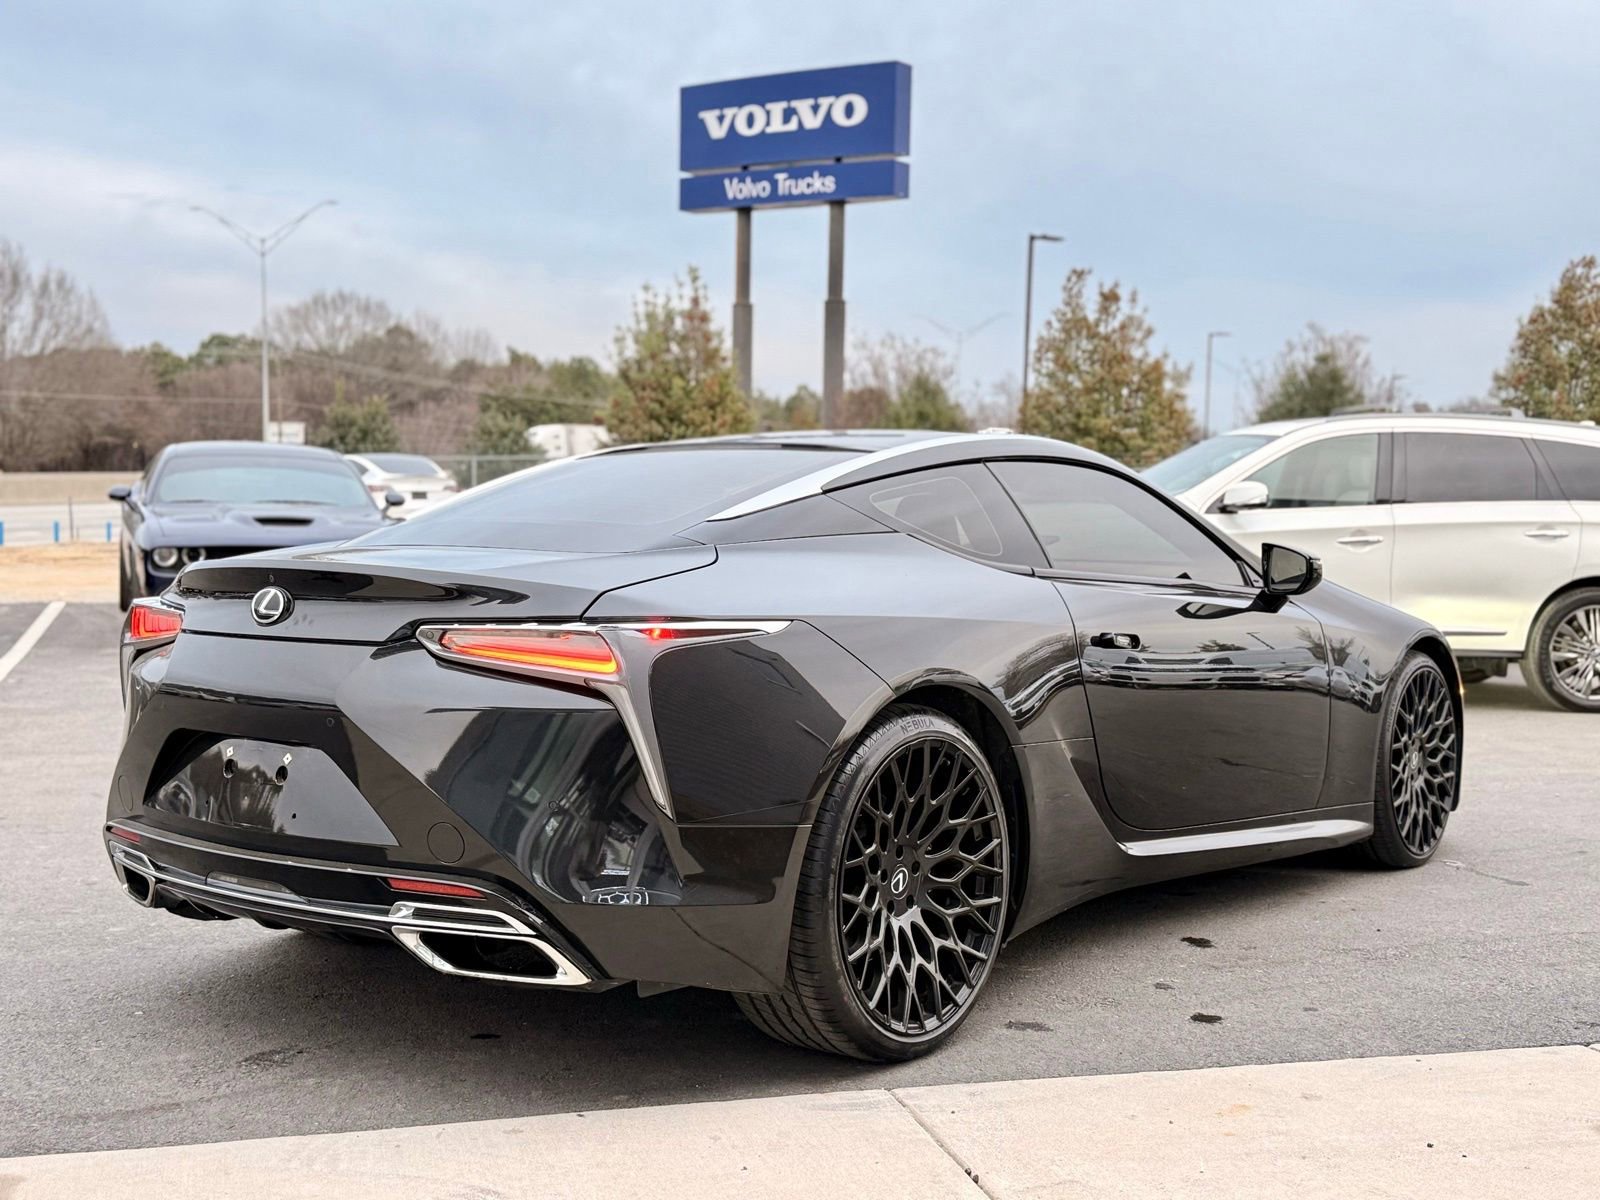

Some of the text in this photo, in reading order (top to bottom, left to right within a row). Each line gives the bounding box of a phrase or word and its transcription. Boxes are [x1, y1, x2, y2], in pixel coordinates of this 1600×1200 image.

[698, 93, 869, 140] VOLVO
[723, 171, 837, 200] Volvo Trucks
